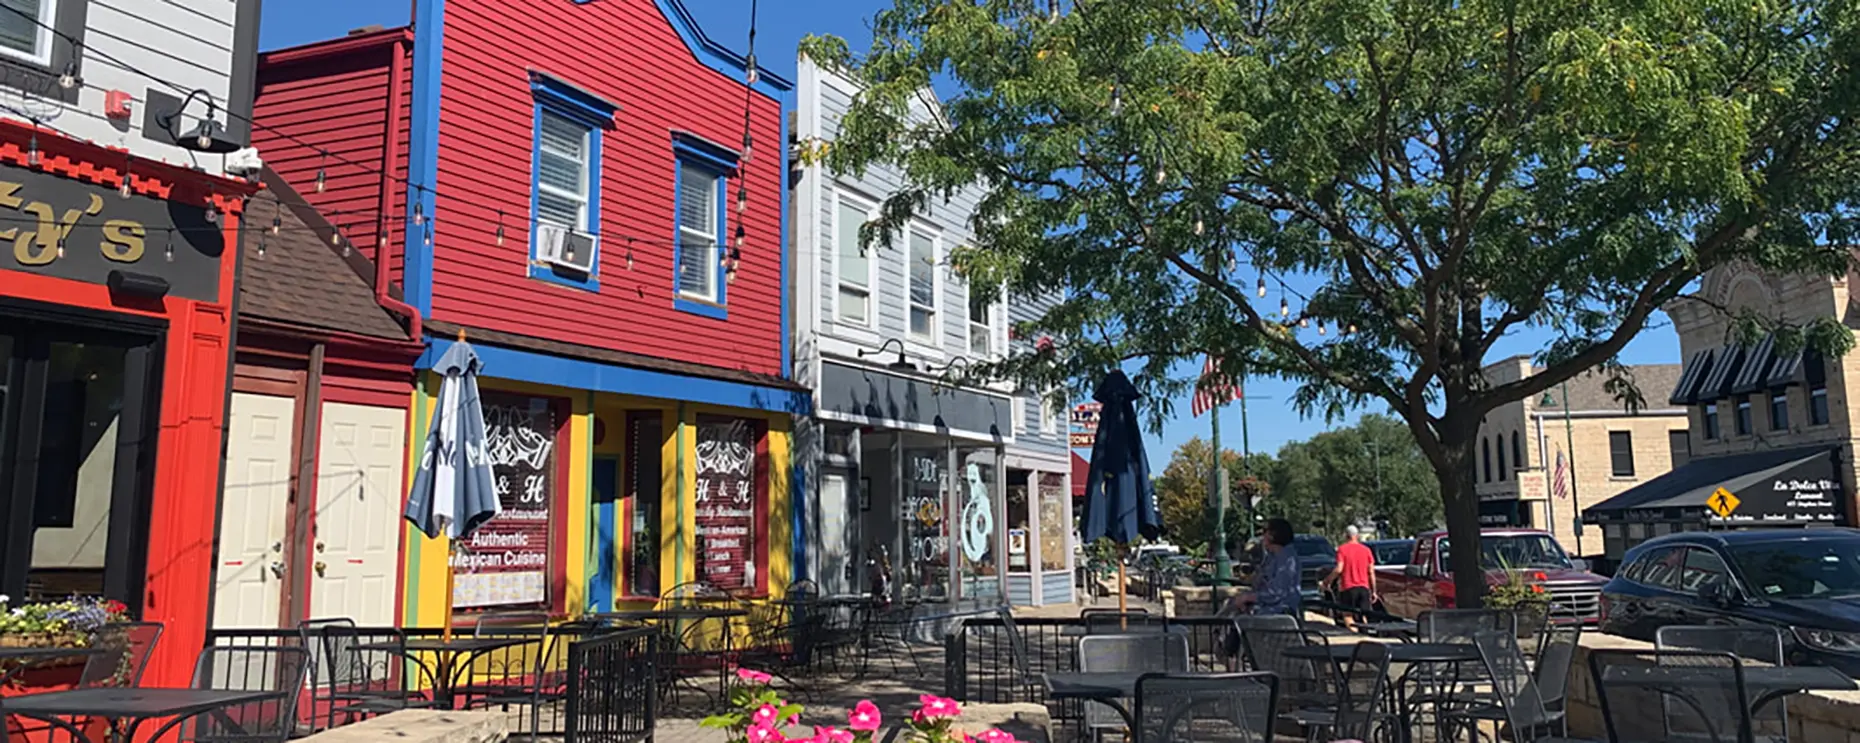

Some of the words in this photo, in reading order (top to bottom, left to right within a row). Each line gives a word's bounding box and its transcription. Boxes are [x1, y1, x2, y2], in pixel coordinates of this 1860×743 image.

[520, 475, 545, 502] H
[696, 479, 709, 501] H
[718, 481, 727, 496] &
[733, 480, 750, 503] H
[471, 532, 529, 546] Authentic
[503, 551, 545, 565] Cuisine
